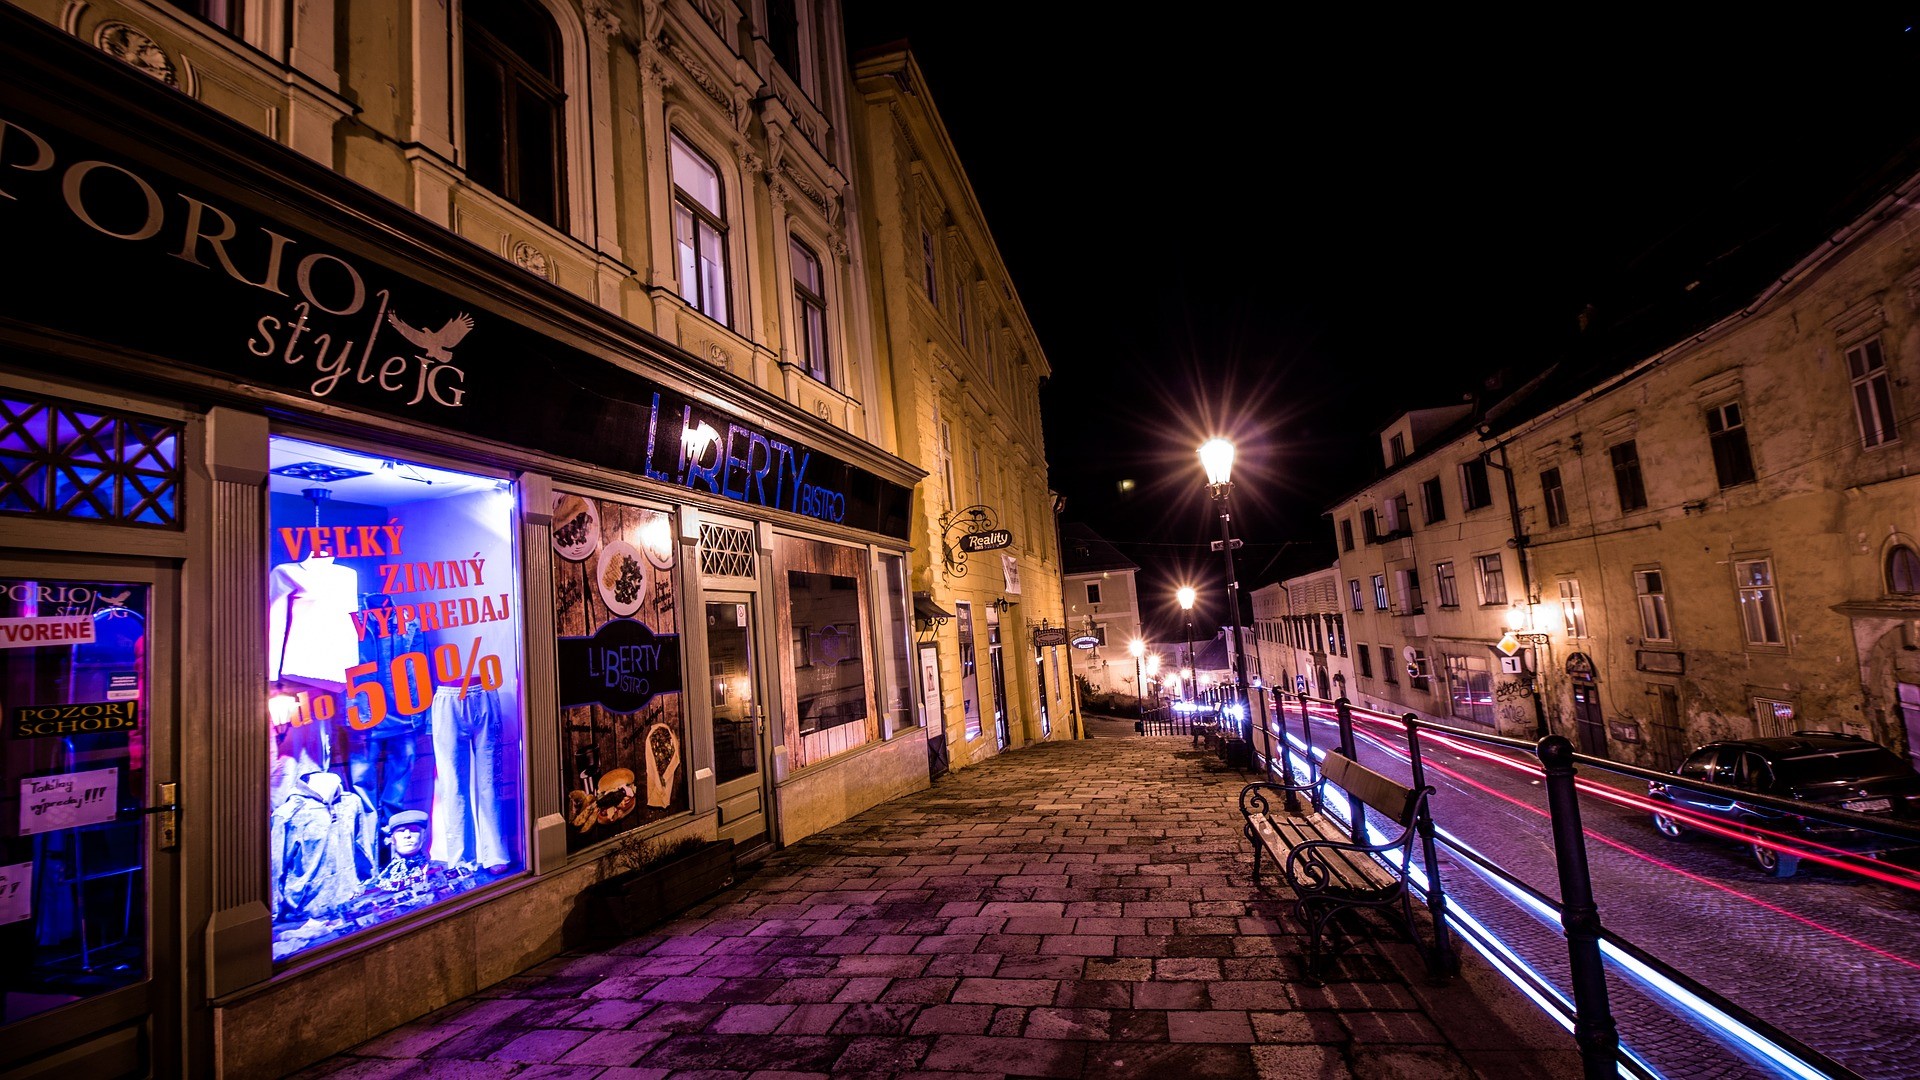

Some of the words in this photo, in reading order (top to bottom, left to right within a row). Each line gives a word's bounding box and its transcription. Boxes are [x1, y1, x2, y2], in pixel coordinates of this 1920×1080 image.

[247, 289, 404, 397] style
[801, 483, 846, 523] BISTRO
[279, 517, 404, 562] VEĽKÝ
[969, 532, 1008, 547] Reality
[379, 552, 487, 596] ZIMNÝ
[350, 593, 511, 644] VÝPREDAJ
[291, 690, 336, 729] do
[345, 635, 505, 732] 50%
